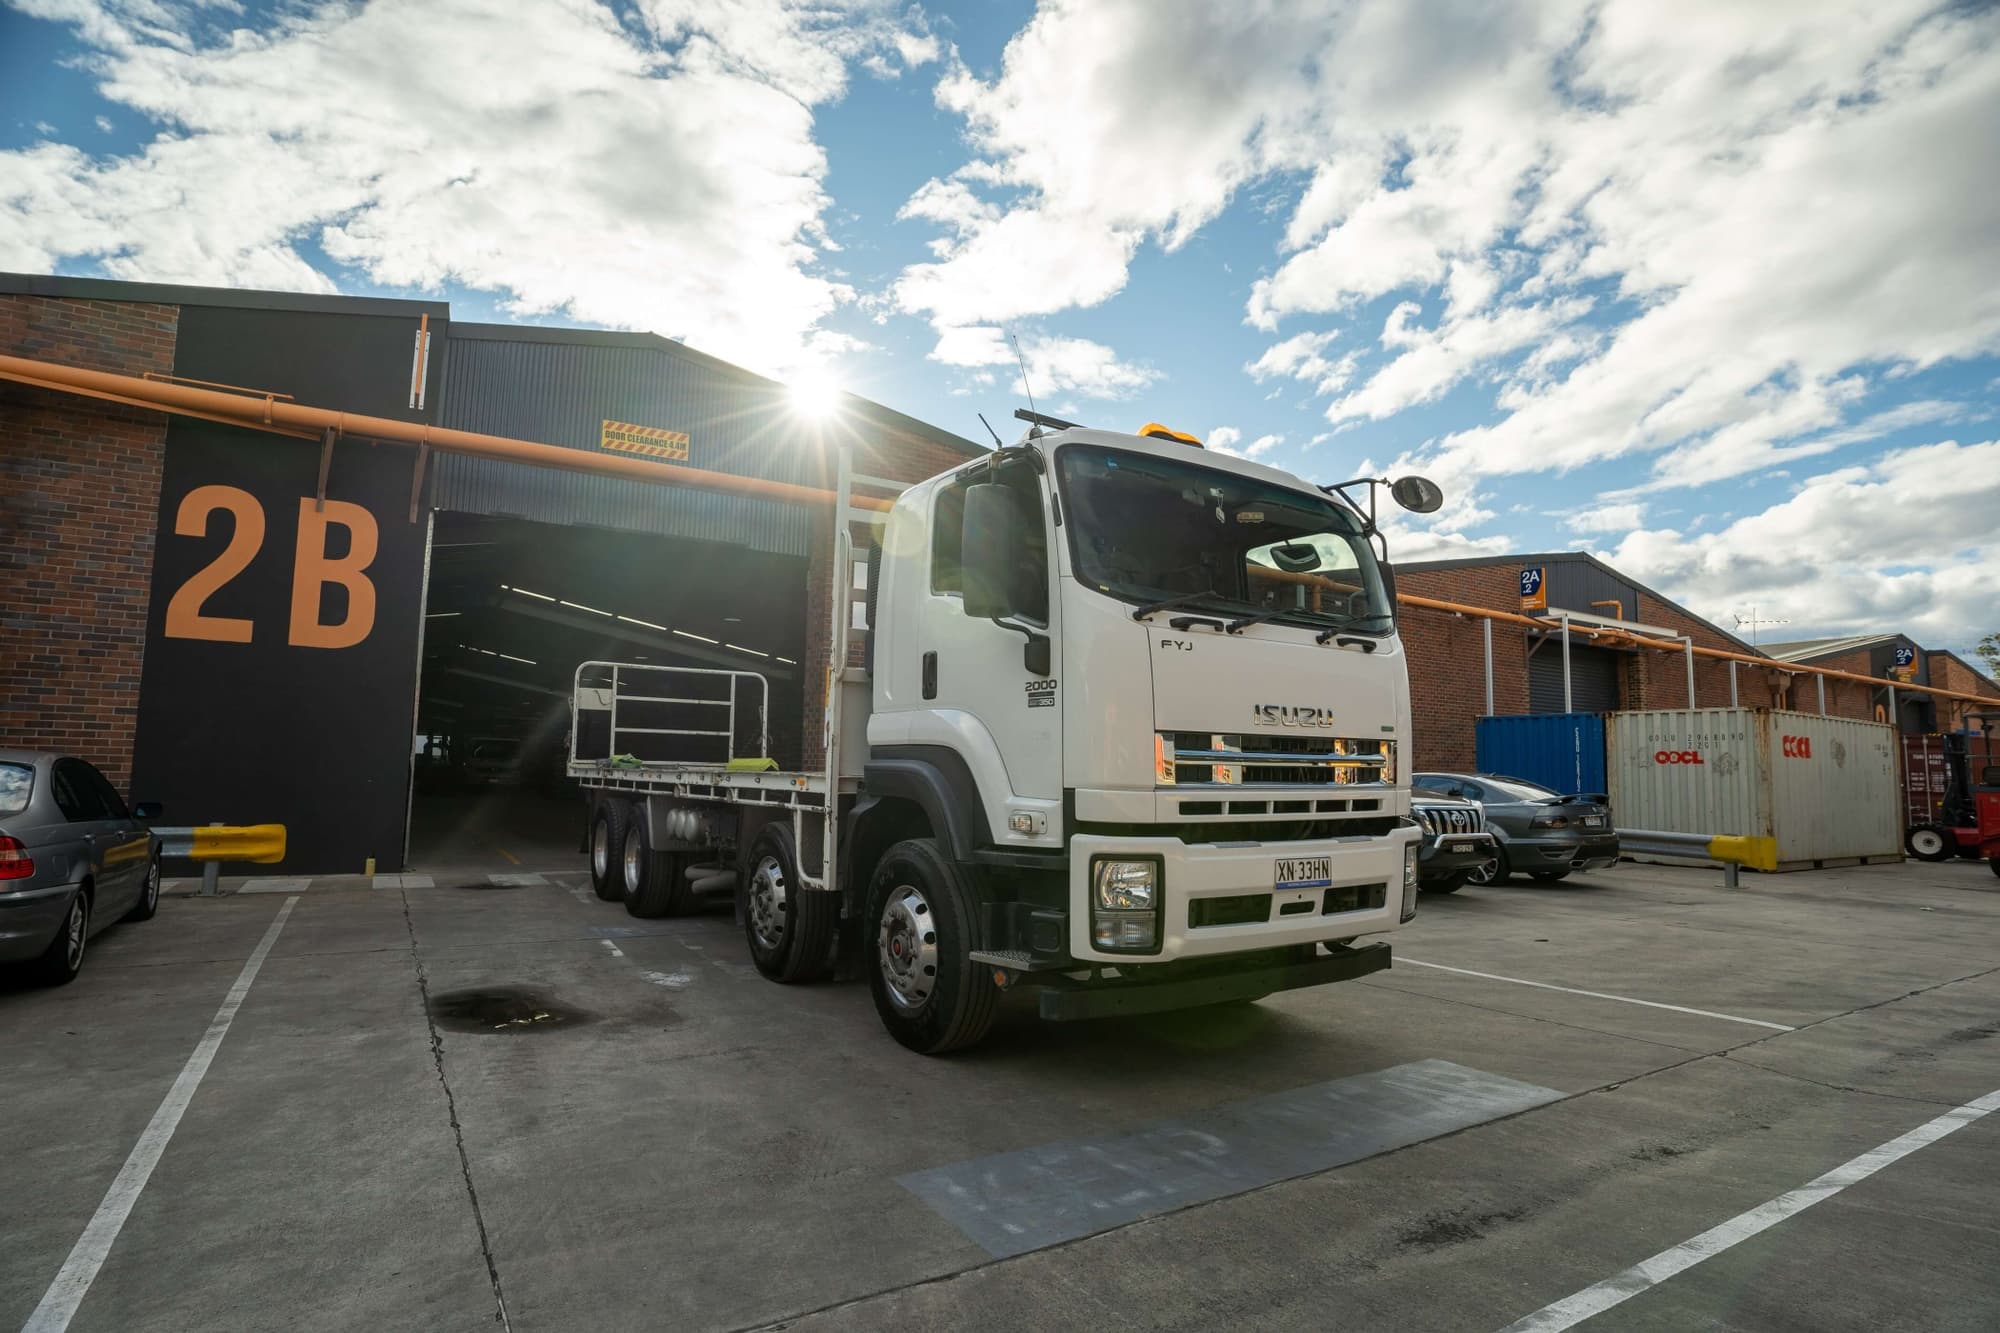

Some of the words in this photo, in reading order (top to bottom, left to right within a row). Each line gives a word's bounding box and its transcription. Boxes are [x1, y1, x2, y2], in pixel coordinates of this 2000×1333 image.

[605, 430, 626, 440] DOOR
[627, 433, 668, 449] CLEARANCE
[164, 484, 379, 649] 2B
[1522, 570, 1540, 584] 2A
[1161, 639, 1193, 651] FYJ
[1896, 649, 1913, 658] 2A
[1025, 679, 1057, 692] 2000
[1254, 704, 1334, 729] ISUZU
[1655, 751, 1704, 765] OOCL
